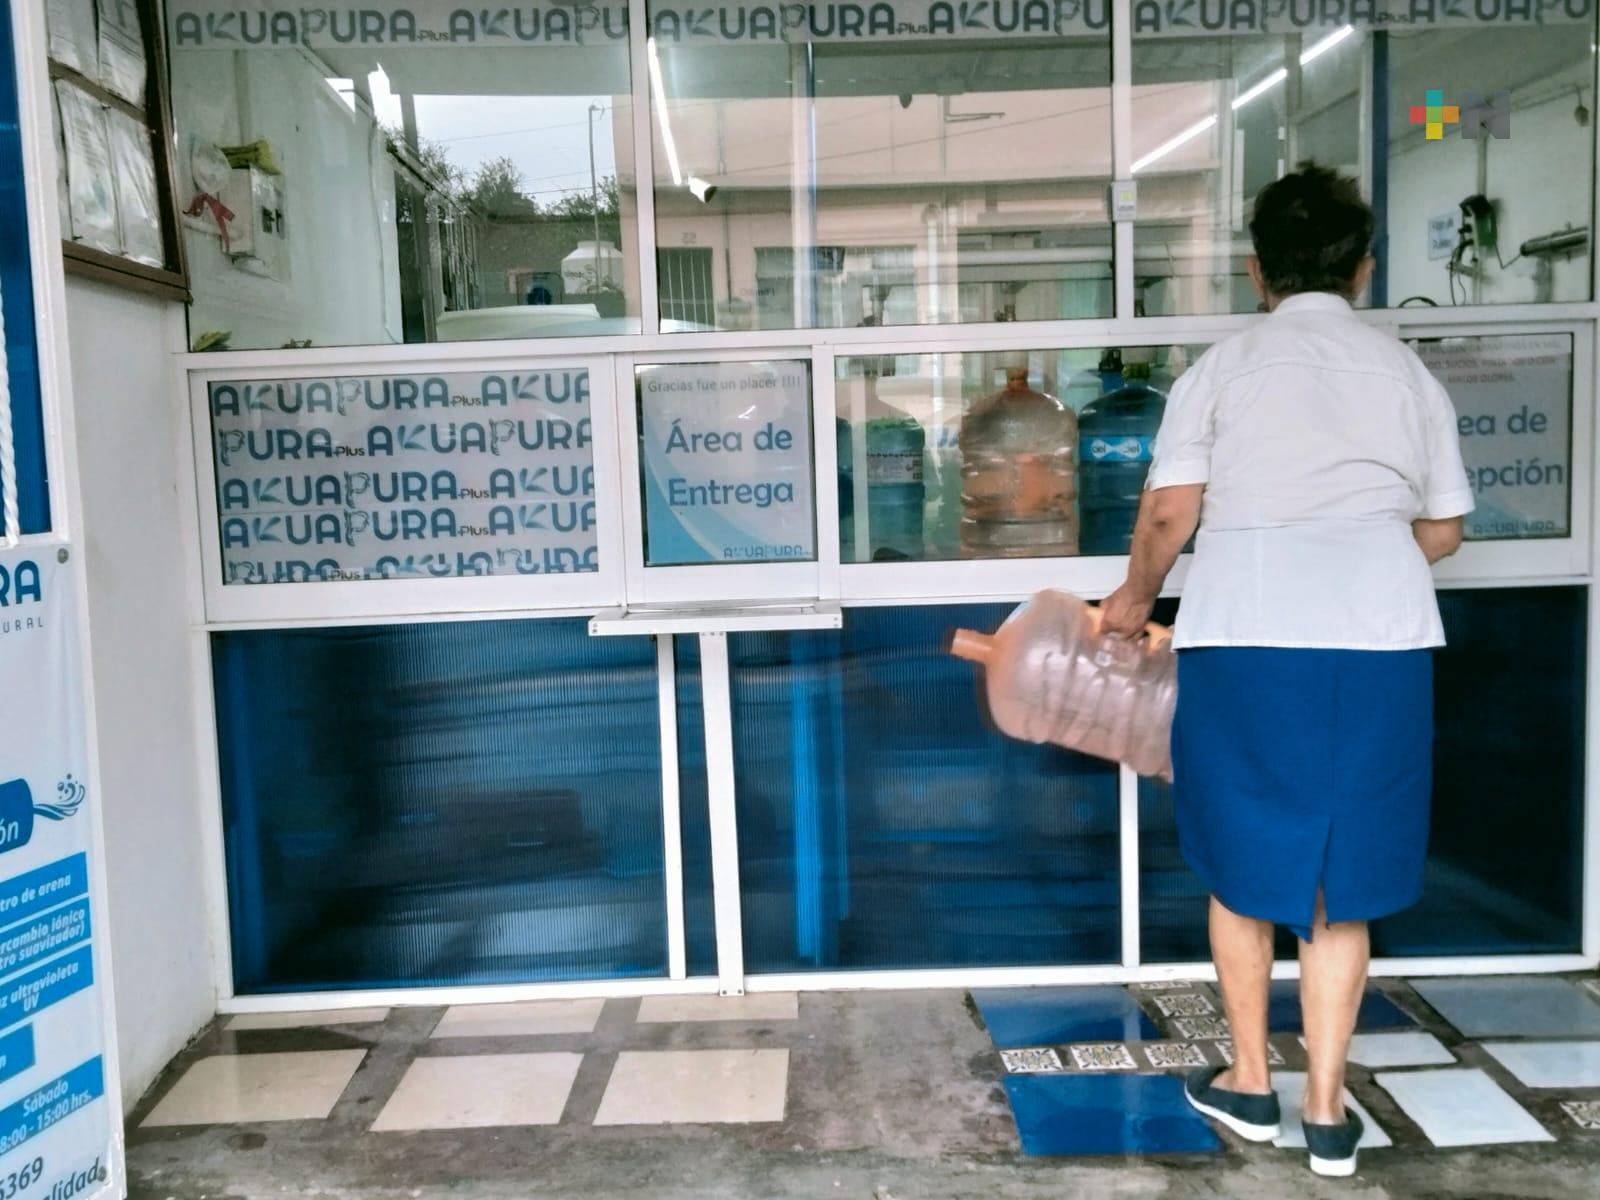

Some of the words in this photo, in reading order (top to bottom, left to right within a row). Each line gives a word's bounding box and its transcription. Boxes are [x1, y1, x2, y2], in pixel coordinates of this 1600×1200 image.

[176, 8, 416, 46] AKUAPURA
[653, 2, 895, 43] AKUAPURA
[213, 377, 449, 417] AKUAPURA
[648, 379, 693, 393] Gracias
[697, 377, 721, 391] fue
[720, 379, 737, 390] un
[740, 377, 777, 391] placer
[665, 418, 742, 454] Área
[753, 422, 792, 452] de
[1507, 405, 1547, 435] de
[220, 426, 332, 467] PURA
[223, 470, 457, 509] AKUAPURA
[668, 478, 794, 508] Entrega
[223, 506, 456, 549] AKUAPURA
[723, 545, 803, 559] AUAURA
[21, 887, 36, 904] de
[38, 874, 71, 896] arena
[10, 960, 79, 1004] ultravioleta
[24, 991, 39, 1012] UV
[23, 1079, 69, 1118] Sábado
[37, 1099, 69, 1130] 15:00
